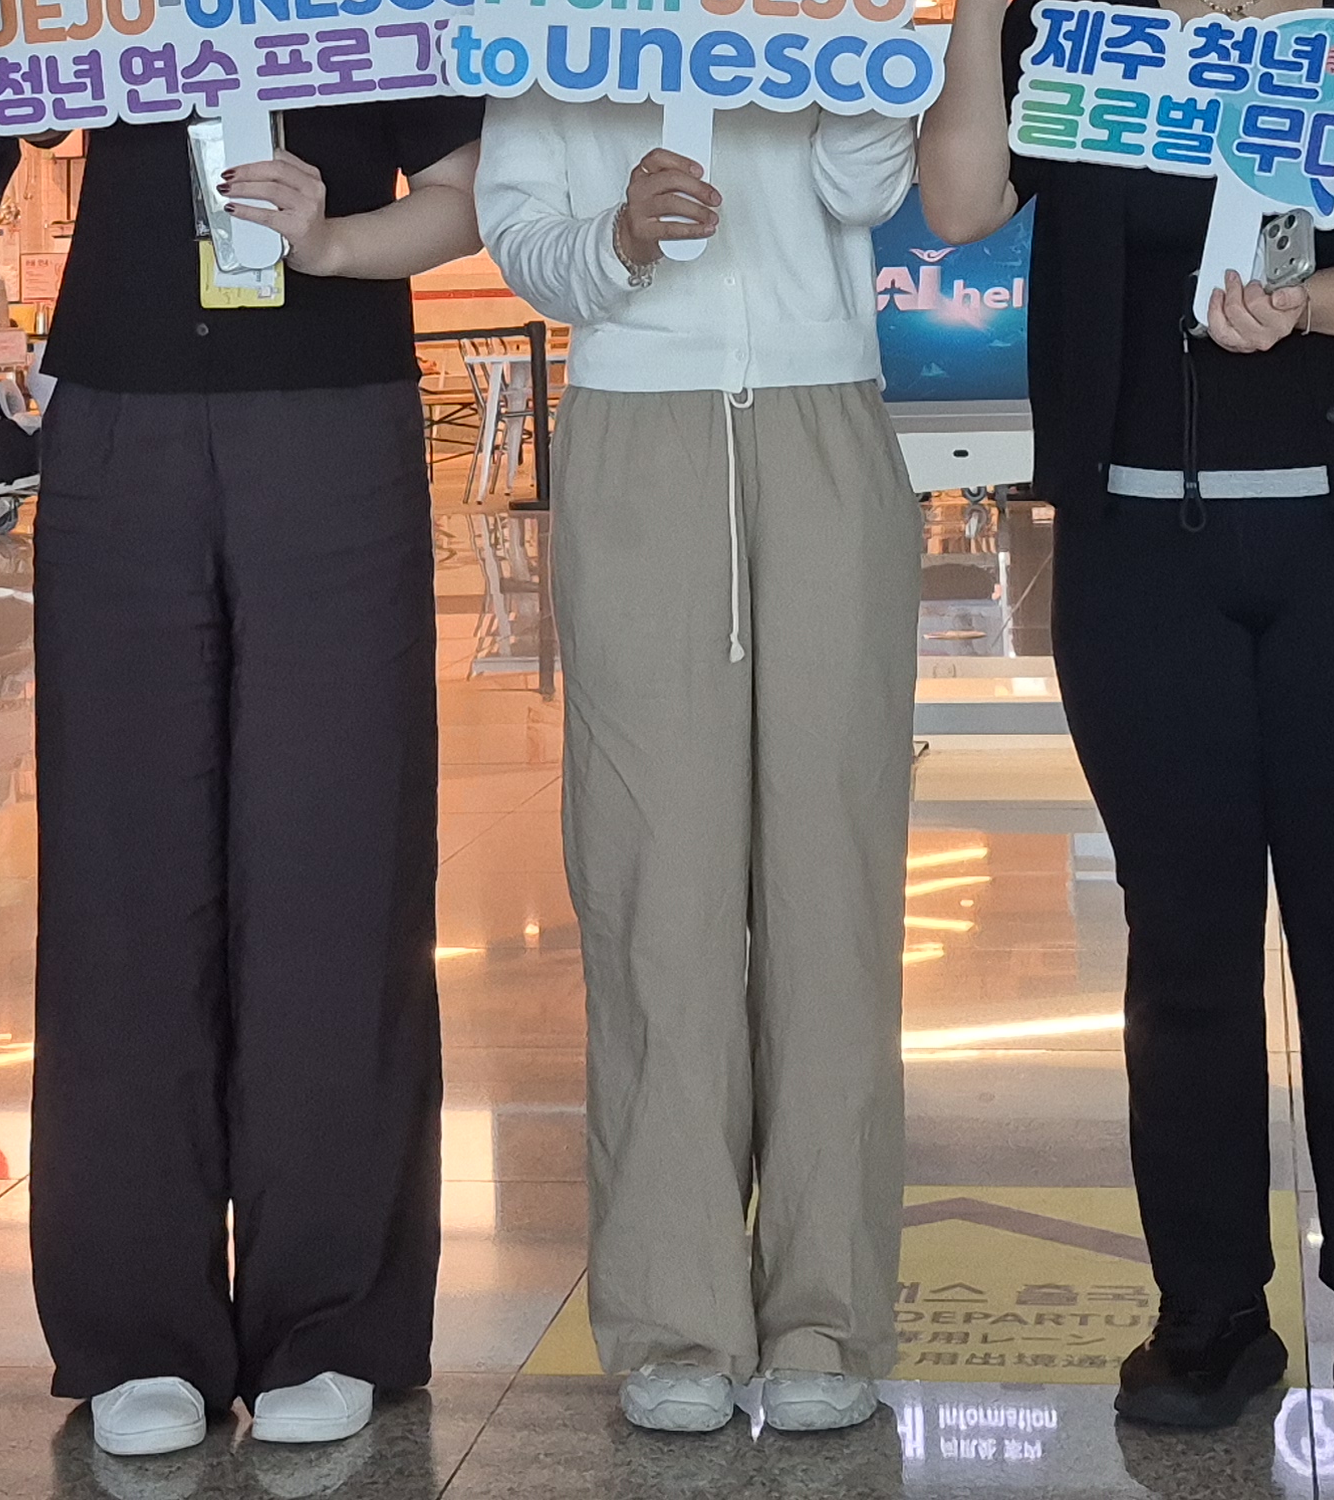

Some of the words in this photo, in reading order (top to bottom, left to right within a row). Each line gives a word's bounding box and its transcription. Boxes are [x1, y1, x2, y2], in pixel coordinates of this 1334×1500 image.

[119, 39, 241, 111] 연수
[254, 18, 450, 101] 프로그
[451, 25, 530, 87] to
[546, 24, 933, 105] unesco
[1030, 8, 1171, 80] 제주
[1188, 22, 1329, 100] 청년
[1017, 79, 1221, 166] 글로벌
[895, 1310, 1159, 1328] DEPARTU
